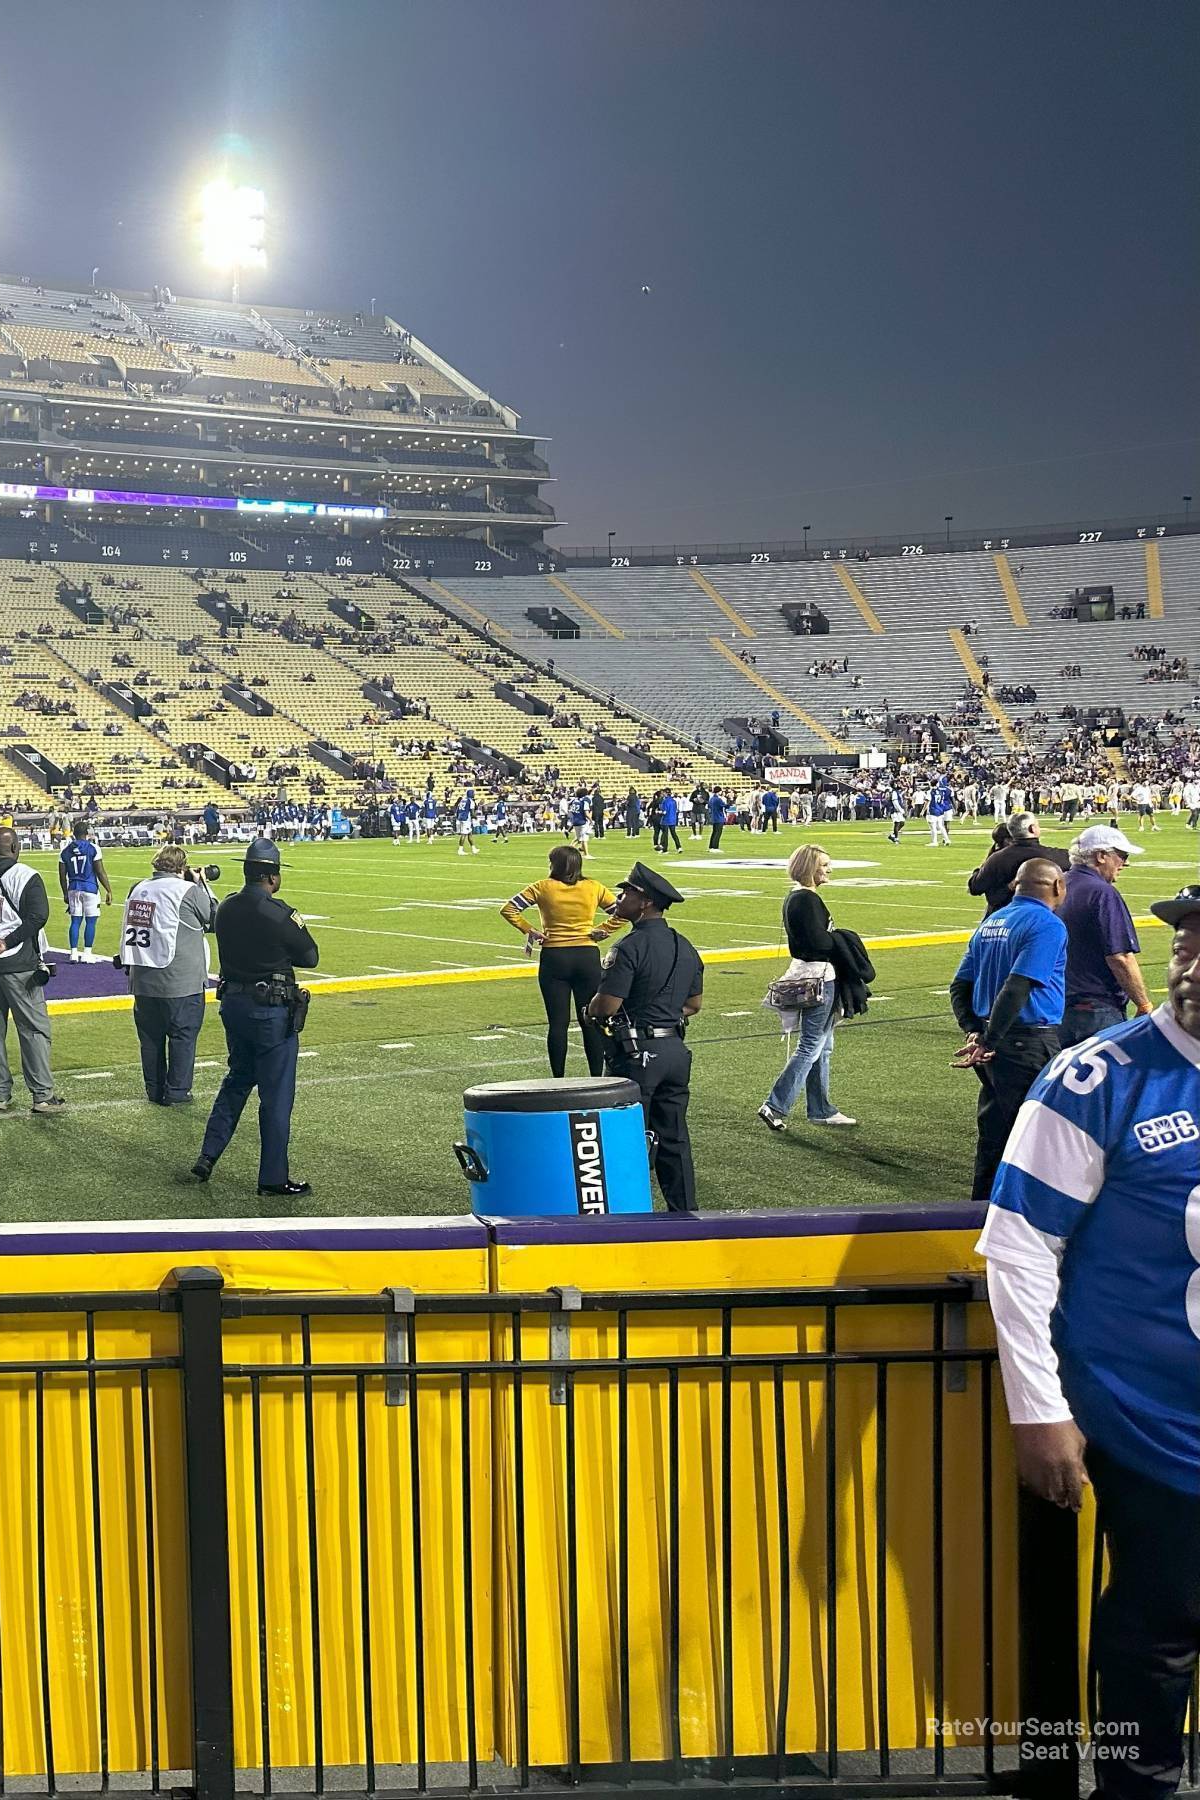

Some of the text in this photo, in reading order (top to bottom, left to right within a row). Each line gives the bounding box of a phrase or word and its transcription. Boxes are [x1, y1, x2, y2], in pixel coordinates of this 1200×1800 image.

[1079, 531, 1102, 544] 227
[101, 545, 121, 557] 104
[901, 544, 924, 556] 226
[228, 551, 247, 563] 105
[335, 556, 353, 567] 106
[610, 557, 630, 568] 224
[750, 553, 770, 564] 225
[392, 558, 411, 570] 222
[474, 560, 492, 571] 223
[768, 767, 807, 780] MANDA
[70, 855, 87, 875] 17
[125, 927, 151, 948] 23
[1135, 1111, 1198, 1152] SBC
